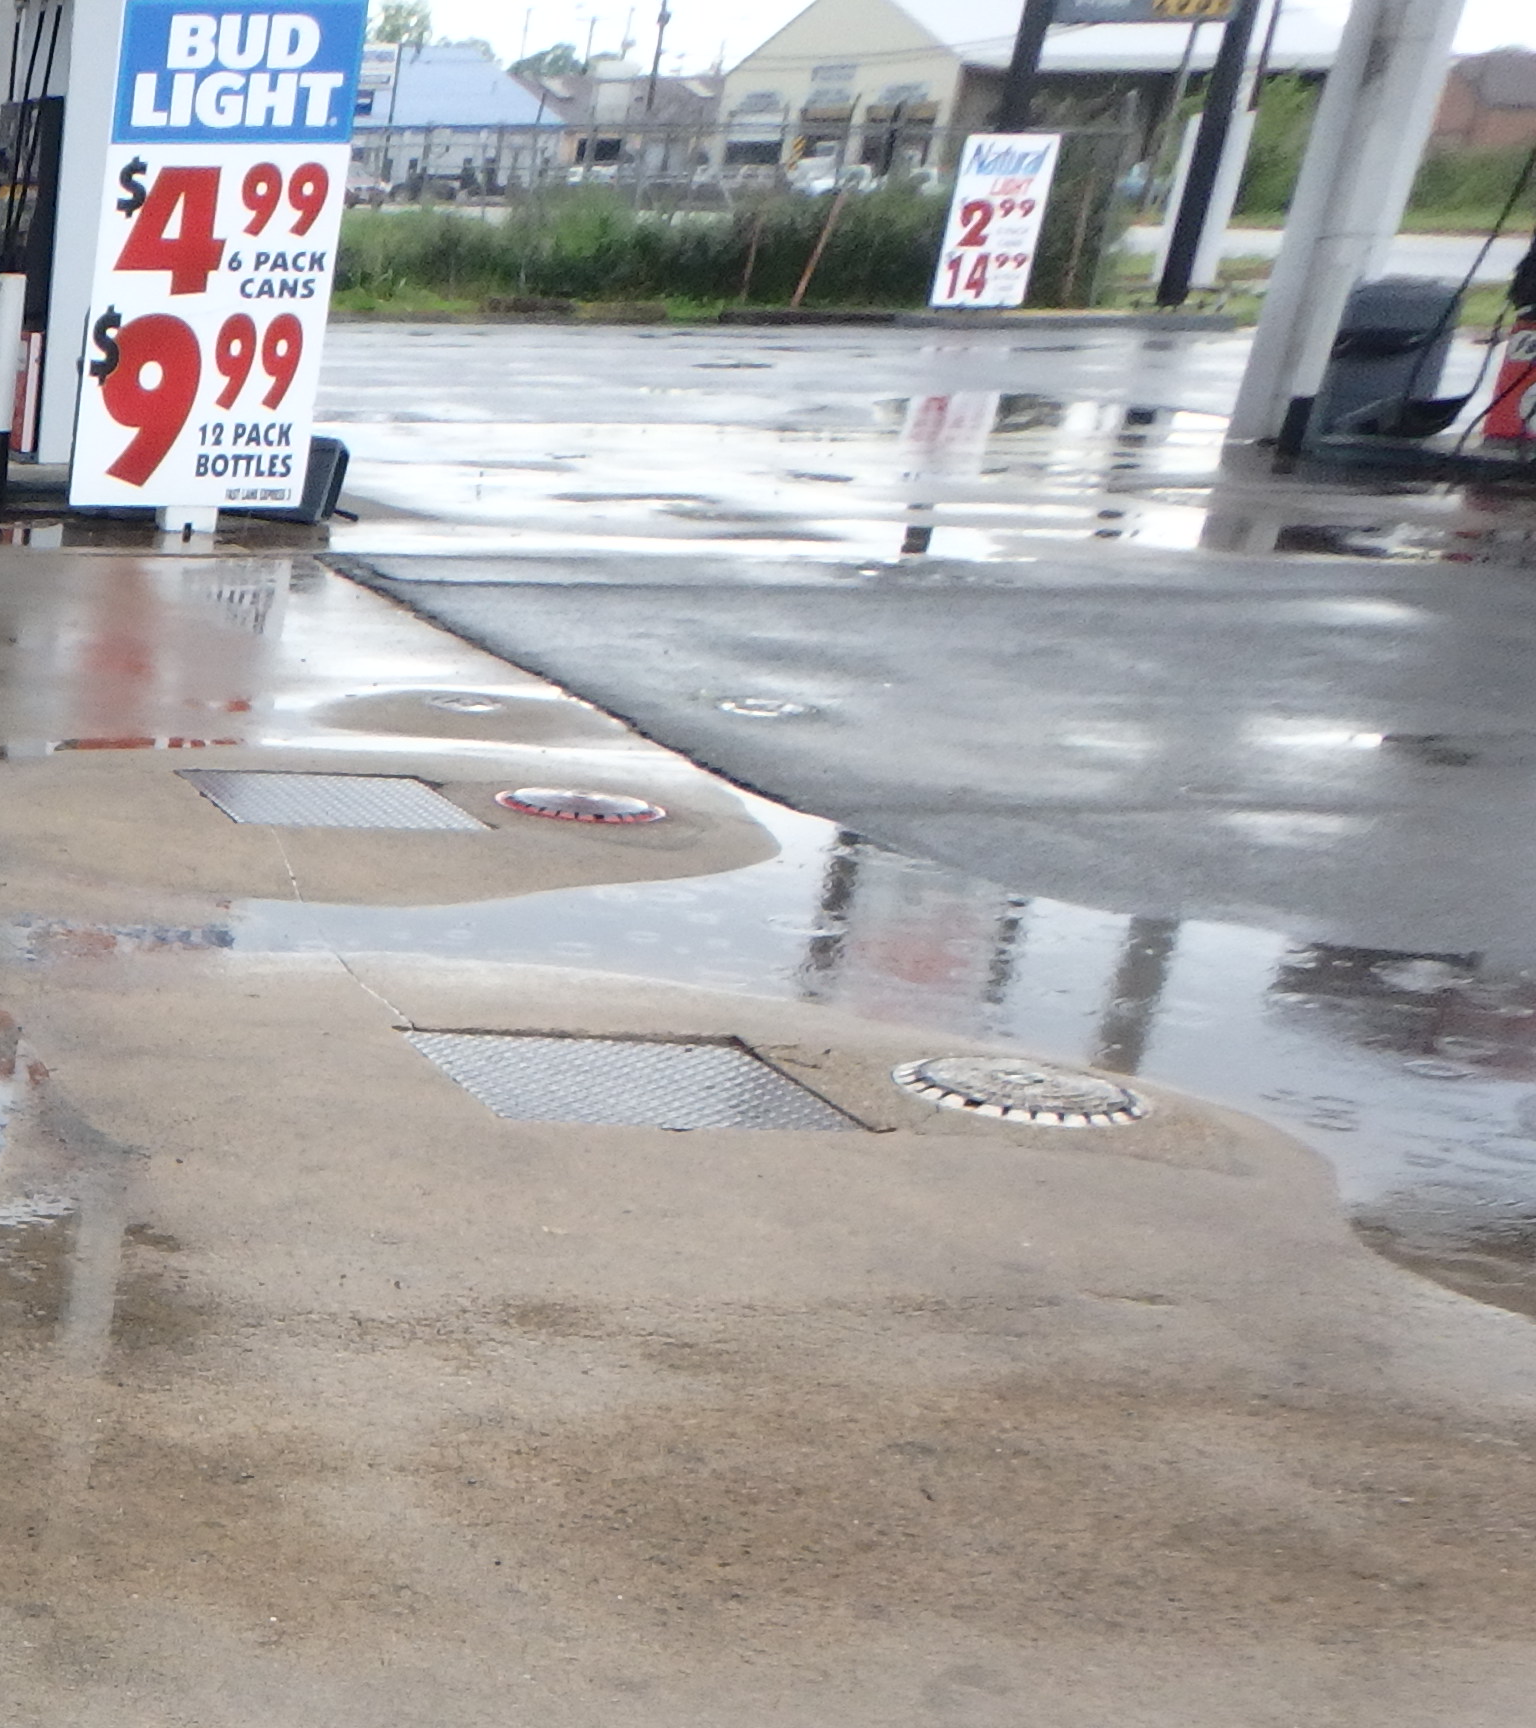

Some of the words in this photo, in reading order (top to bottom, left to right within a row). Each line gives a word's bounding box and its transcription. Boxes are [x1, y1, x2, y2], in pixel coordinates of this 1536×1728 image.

[166, 13, 321, 70] BUD
[130, 71, 345, 128] LIGHT
[962, 141, 1053, 176] Natural
[227, 250, 243, 272] 6
[254, 250, 326, 273] PACK
[239, 277, 316, 299] CANS
[198, 421, 225, 447] 12
[232, 421, 294, 447] PACK
[194, 453, 294, 478] BOTTLES
